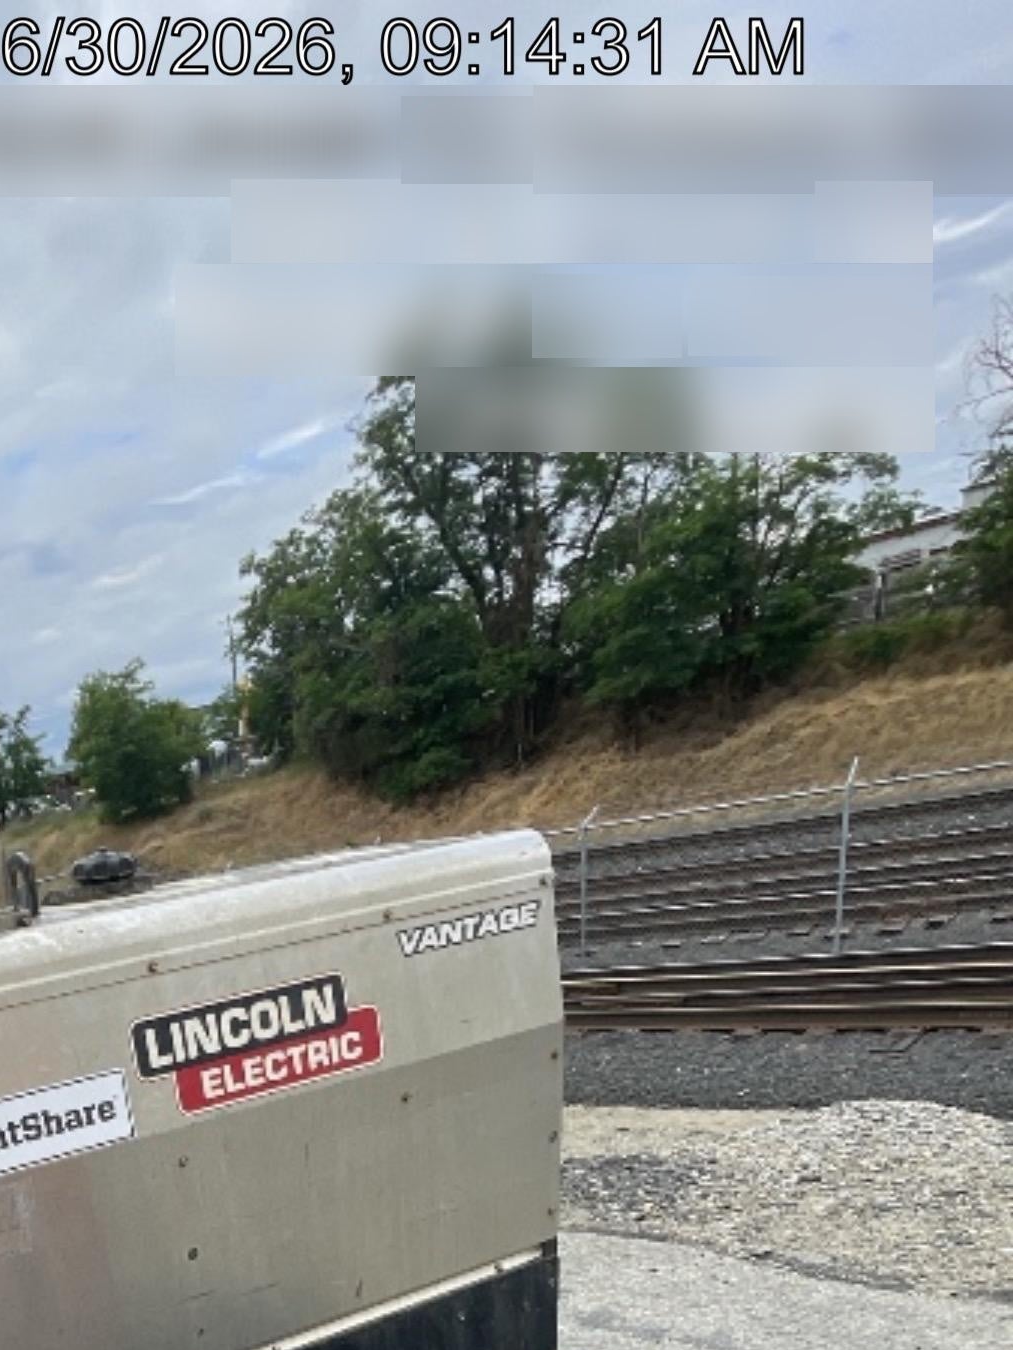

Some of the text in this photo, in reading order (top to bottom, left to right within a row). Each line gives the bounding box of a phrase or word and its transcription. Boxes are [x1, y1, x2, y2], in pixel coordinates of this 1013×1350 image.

[396, 899, 541, 957] VANTAGE
[145, 983, 337, 1069] LINCOLN
[200, 1030, 364, 1099] ELECTRIC
